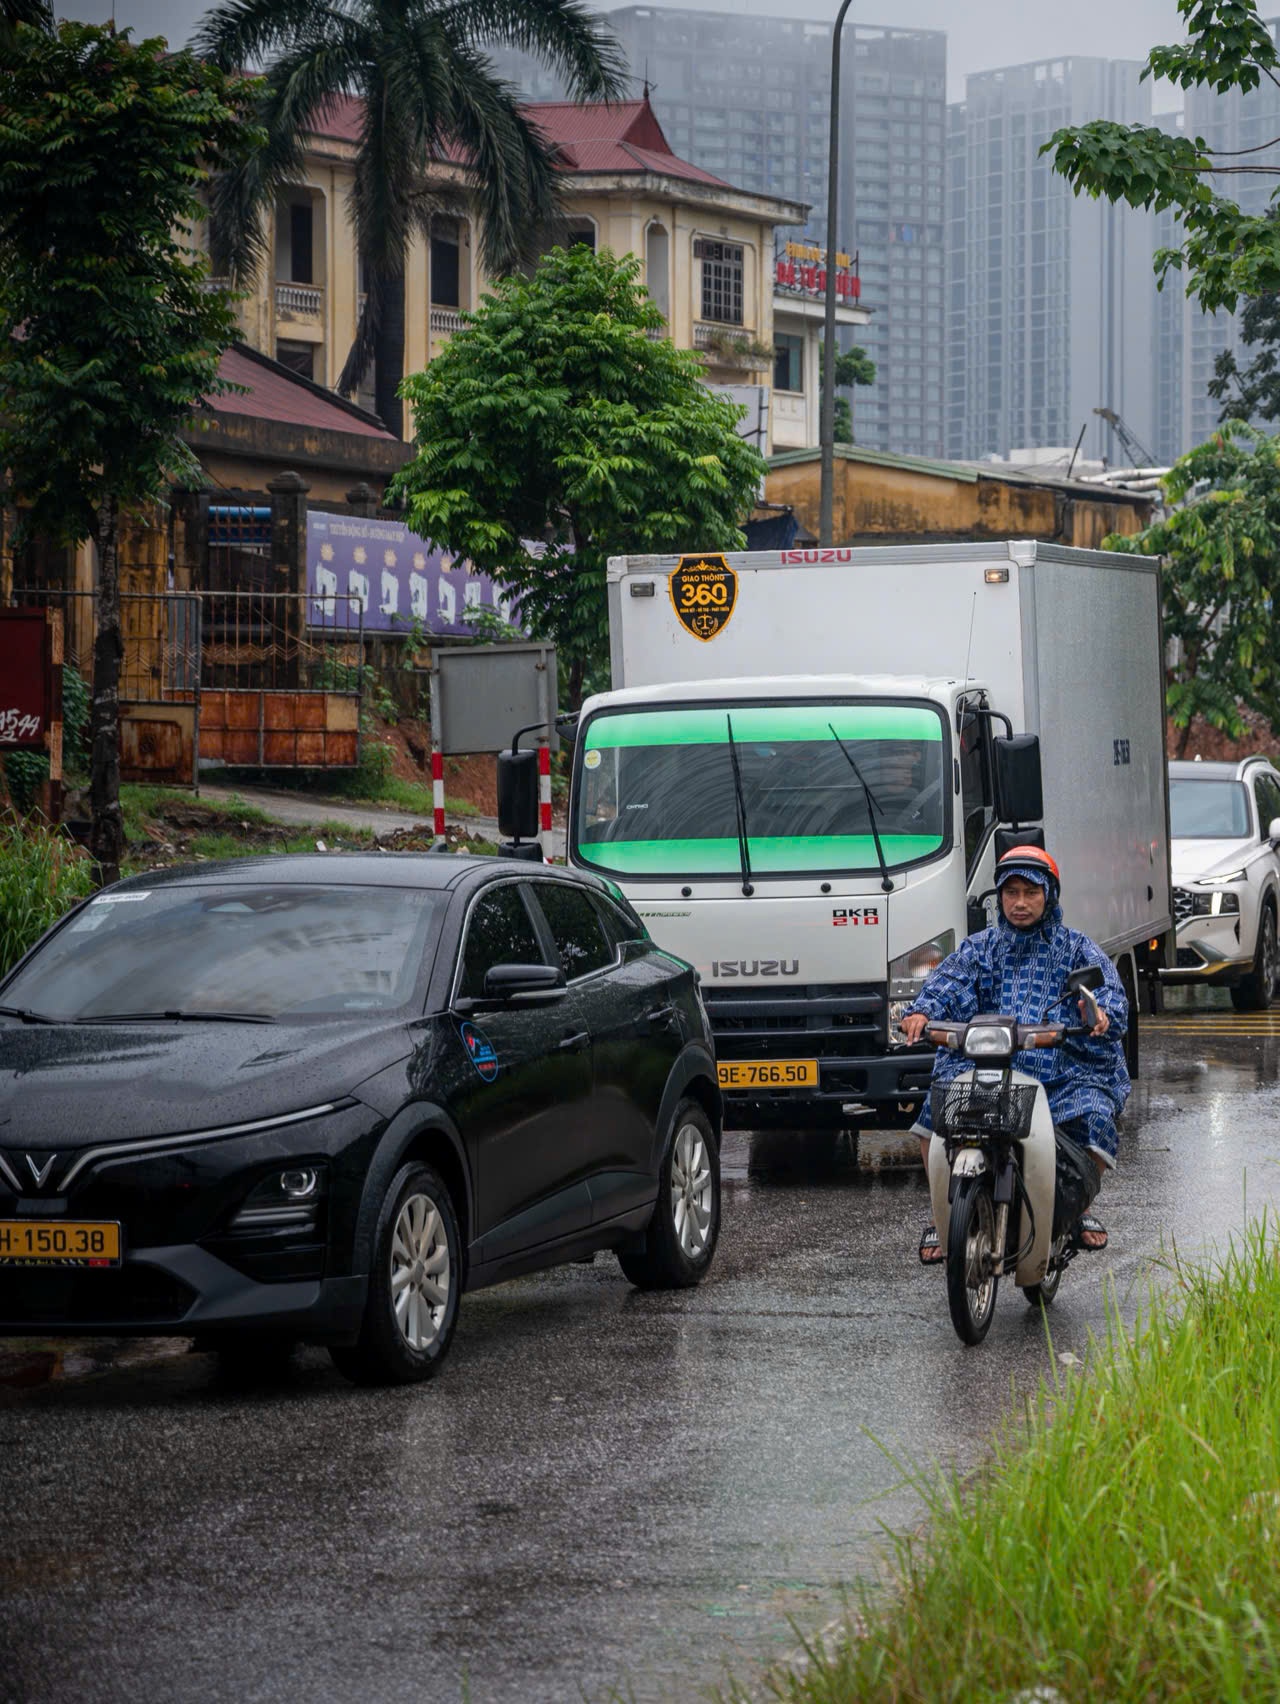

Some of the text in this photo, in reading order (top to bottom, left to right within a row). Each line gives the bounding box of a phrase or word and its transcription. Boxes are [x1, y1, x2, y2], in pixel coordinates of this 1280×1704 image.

[781, 549, 852, 565] ISUZU
[681, 572, 726, 583] GIAO THÔNG
[681, 583, 728, 606] 360
[832, 908, 878, 917] QKR
[832, 916, 879, 926] 210
[712, 959, 800, 978] ISUZU
[718, 1065, 808, 1084] 9E-766.50
